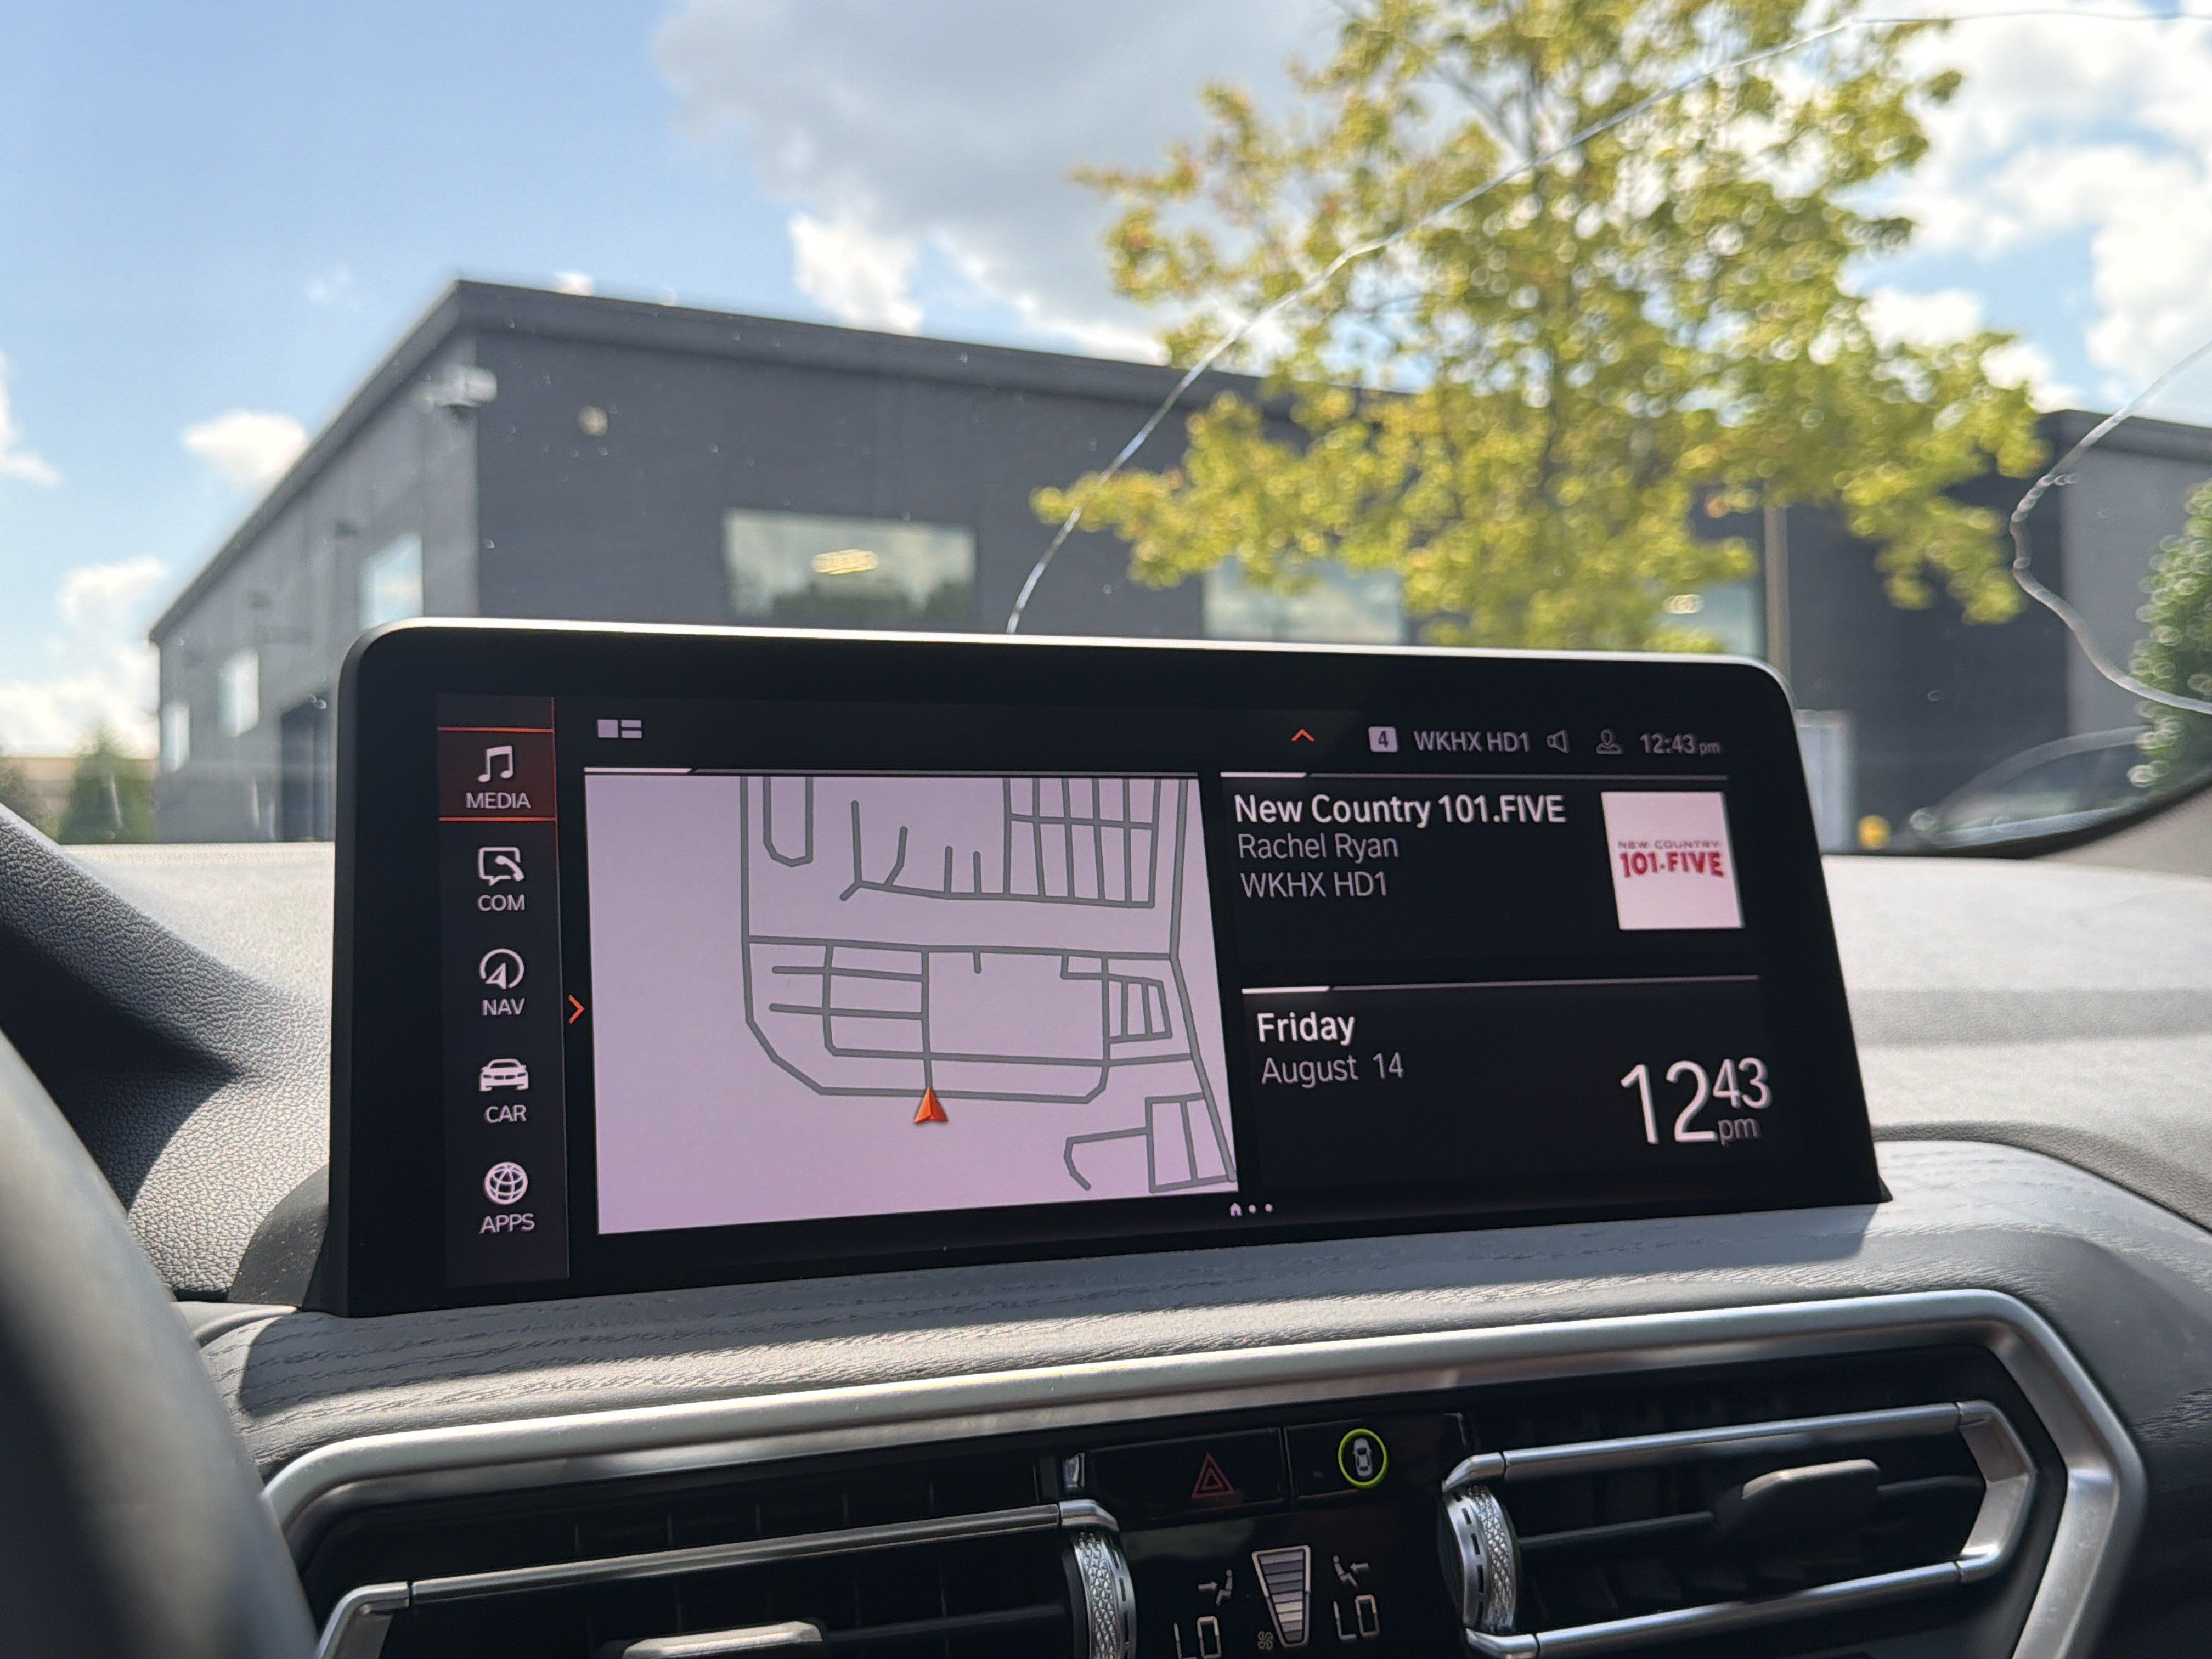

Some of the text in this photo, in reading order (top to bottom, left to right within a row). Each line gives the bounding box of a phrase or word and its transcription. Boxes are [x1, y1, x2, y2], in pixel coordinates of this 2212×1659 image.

[1413, 731, 1531, 752] WKHX HD1
[1640, 732, 1722, 757] 12:43 pm
[466, 792, 532, 809] MEDIA
[1234, 794, 1567, 829] New Country 101.FIVE
[1237, 832, 1400, 864] Rachel Ryan
[1618, 839, 1720, 849] NEW COUNTRY
[1239, 871, 1388, 898] WKHX HD1
[477, 894, 526, 912] COM
[482, 997, 525, 1016] NAV
[1257, 1011, 1356, 1047] Friday
[1261, 1052, 1404, 1090] August 14
[484, 1104, 527, 1124] CAR
[1718, 1118, 1762, 1147] pm
[479, 1212, 535, 1234] APPS
